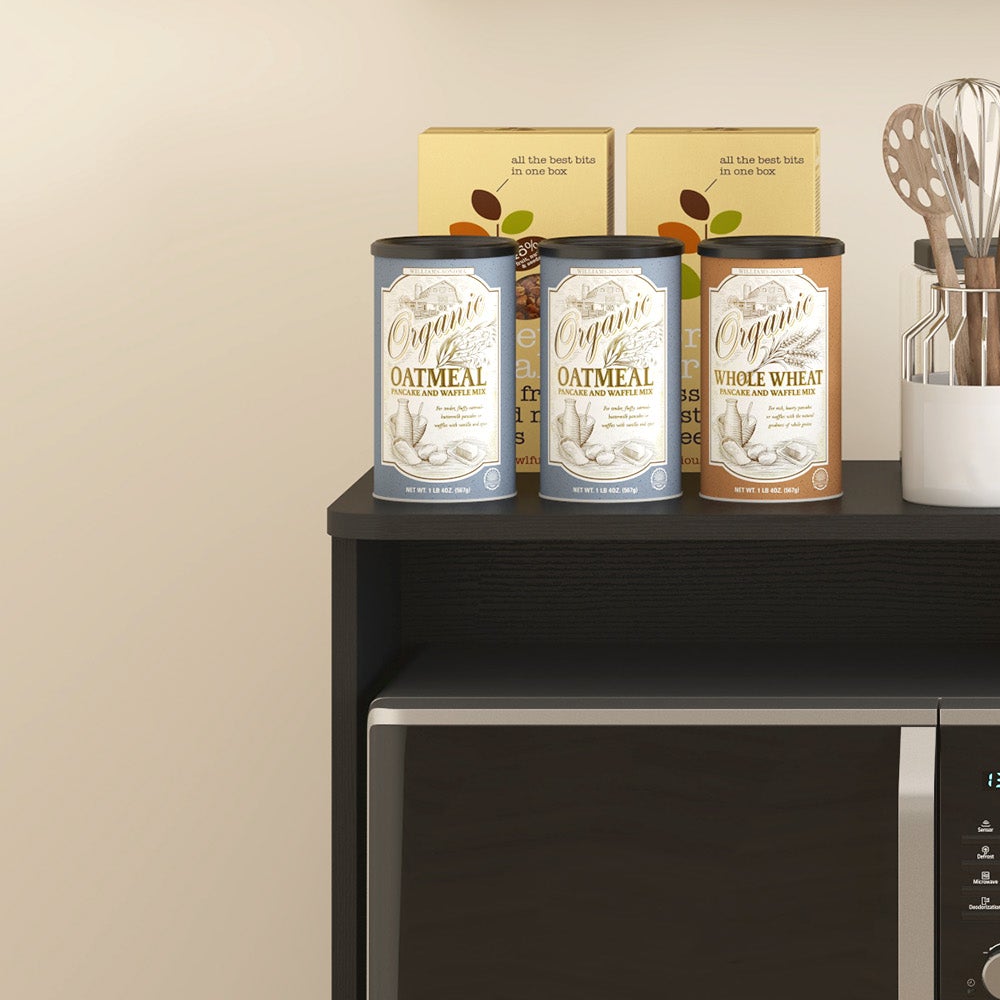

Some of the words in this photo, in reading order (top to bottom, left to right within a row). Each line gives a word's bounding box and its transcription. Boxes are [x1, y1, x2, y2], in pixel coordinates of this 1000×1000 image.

[511, 156, 525, 164] all
[528, 156, 546, 164] the
[549, 156, 573, 164] best
[575, 156, 596, 164] bits
[720, 156, 734, 164] all
[736, 156, 755, 164] the
[758, 156, 781, 164] best
[784, 156, 804, 164] bits
[511, 167, 523, 175] in
[548, 167, 567, 175] box
[720, 167, 731, 175] in
[756, 167, 776, 175] box
[388, 292, 485, 364] Organic
[554, 292, 652, 364] Organic
[716, 292, 814, 364] Organic
[391, 366, 487, 387] OATMEAL
[558, 366, 654, 387] OATMEAL
[714, 369, 765, 386] WHOLE
[769, 370, 823, 386] WHEAT
[558, 388, 588, 396] PANCAKE
[720, 388, 750, 396] PANCAKE
